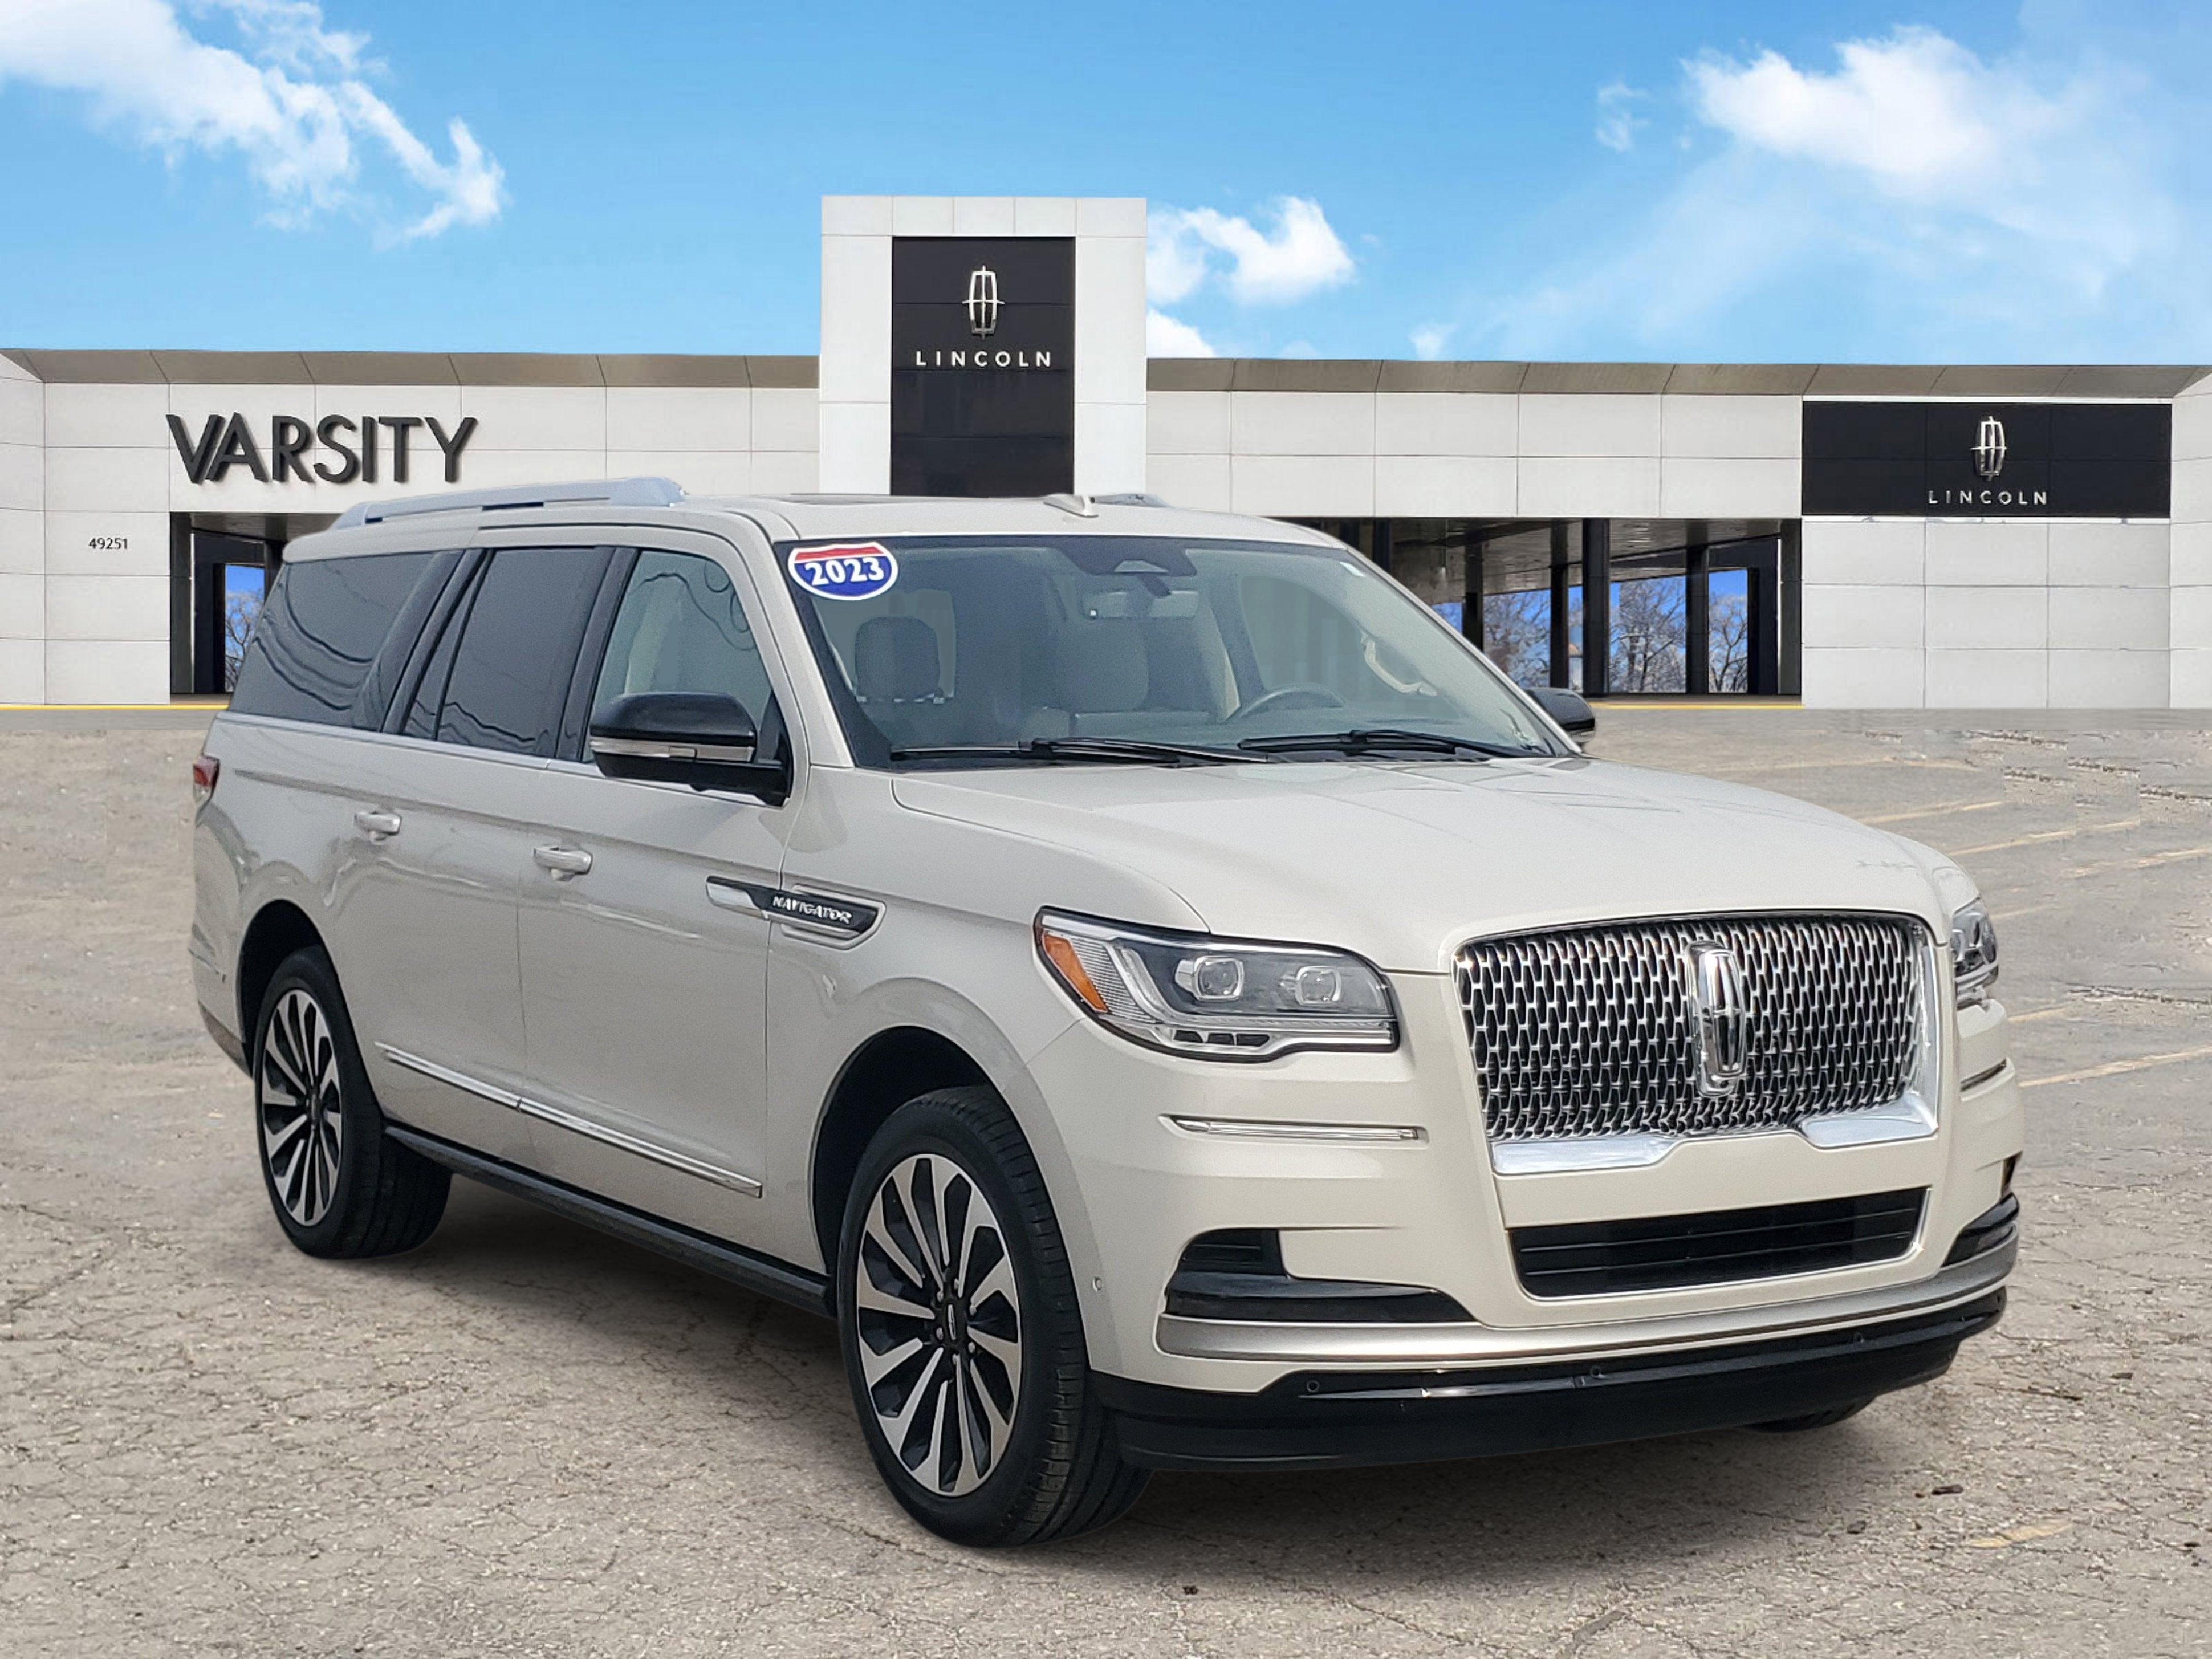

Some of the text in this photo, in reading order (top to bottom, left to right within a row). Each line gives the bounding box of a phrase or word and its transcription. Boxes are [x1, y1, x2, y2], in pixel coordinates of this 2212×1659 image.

[916, 350, 1051, 367] LINCOLN
[165, 413, 478, 485] VARSITY
[1928, 490, 2047, 506] LINCOLN
[88, 538, 128, 550] 49251
[804, 556, 884, 586] 2023
[772, 896, 852, 924] NAVIGATOR
